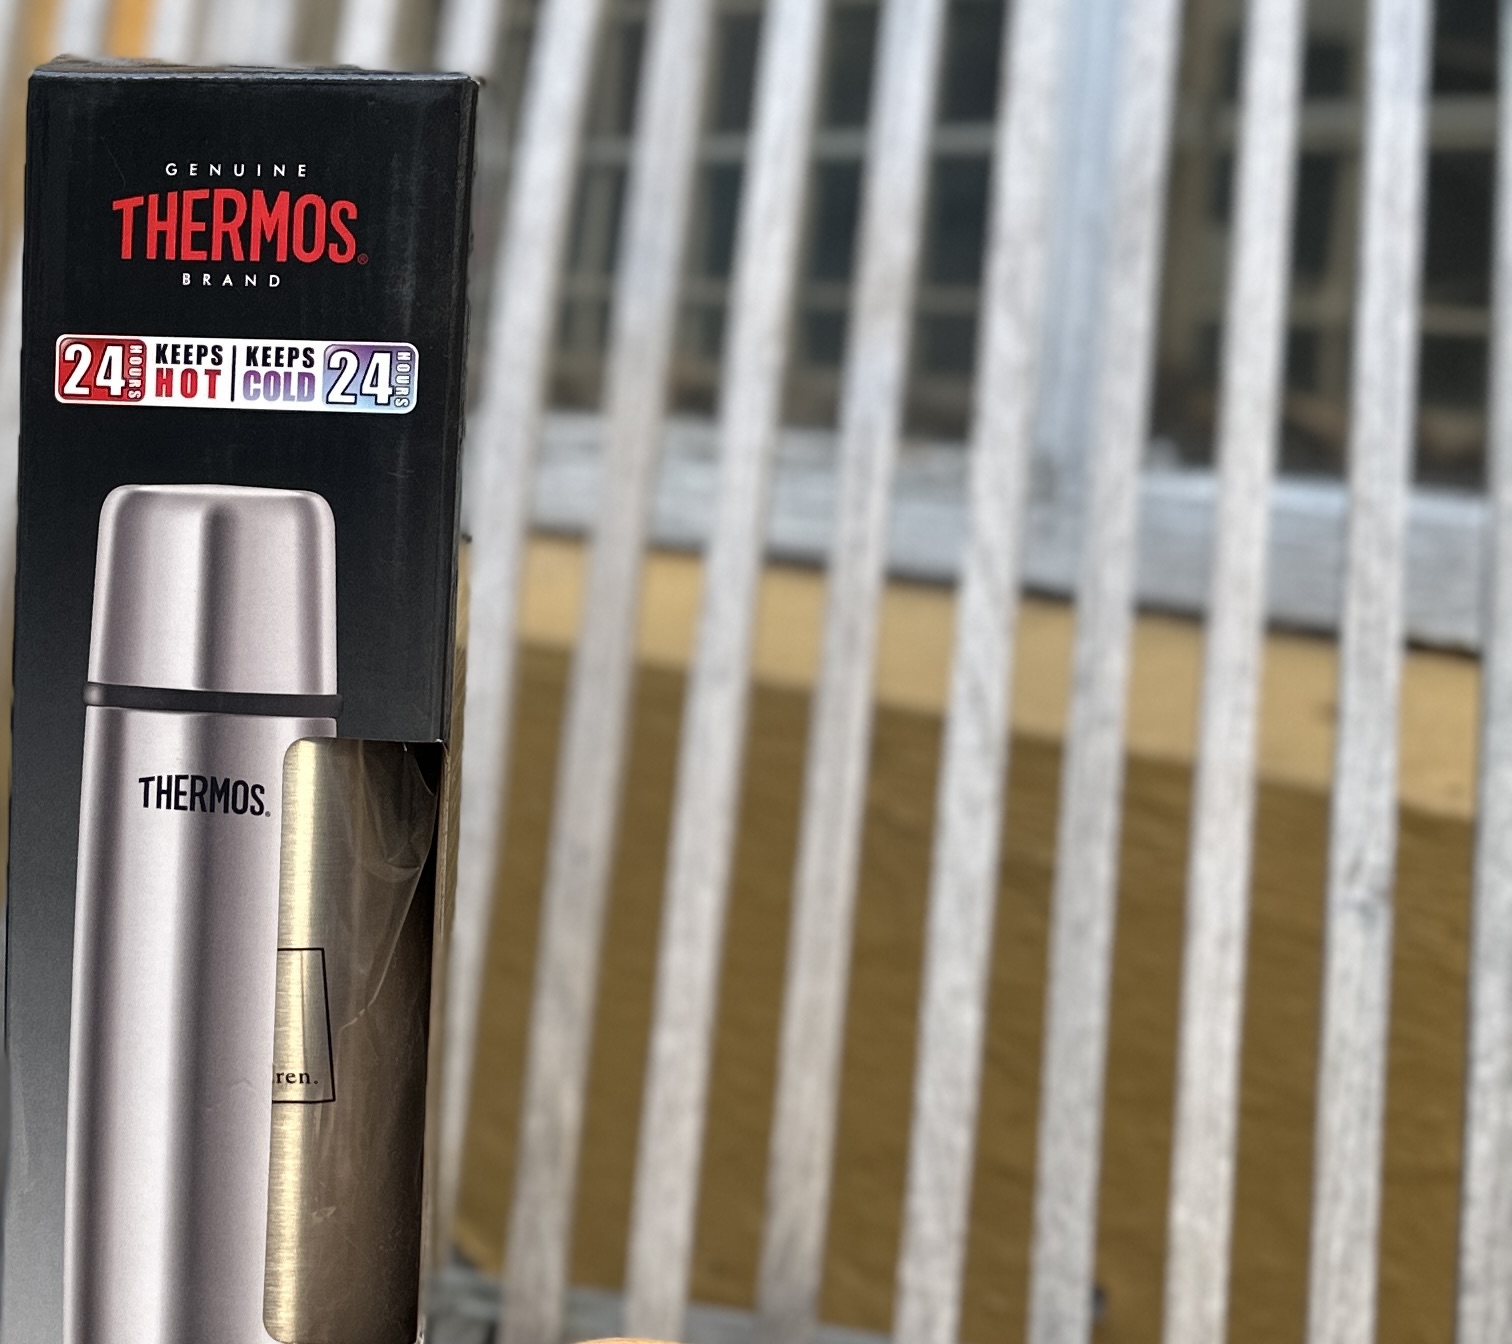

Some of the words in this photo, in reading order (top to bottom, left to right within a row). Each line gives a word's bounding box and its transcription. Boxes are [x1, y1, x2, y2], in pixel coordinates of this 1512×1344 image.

[165, 162, 308, 178] GENUINE
[182, 272, 282, 288] BRAND
[62, 342, 127, 398] 24
[155, 342, 224, 366] KEEPS
[244, 344, 316, 369] KEEPS
[127, 344, 143, 400] HOURS
[154, 367, 222, 400] HOT
[242, 369, 316, 403] COLD
[326, 348, 395, 407] 24
[394, 350, 411, 408] HOURS
[138, 774, 268, 816] THERMOS
[272, 1071, 319, 1086] ren.
